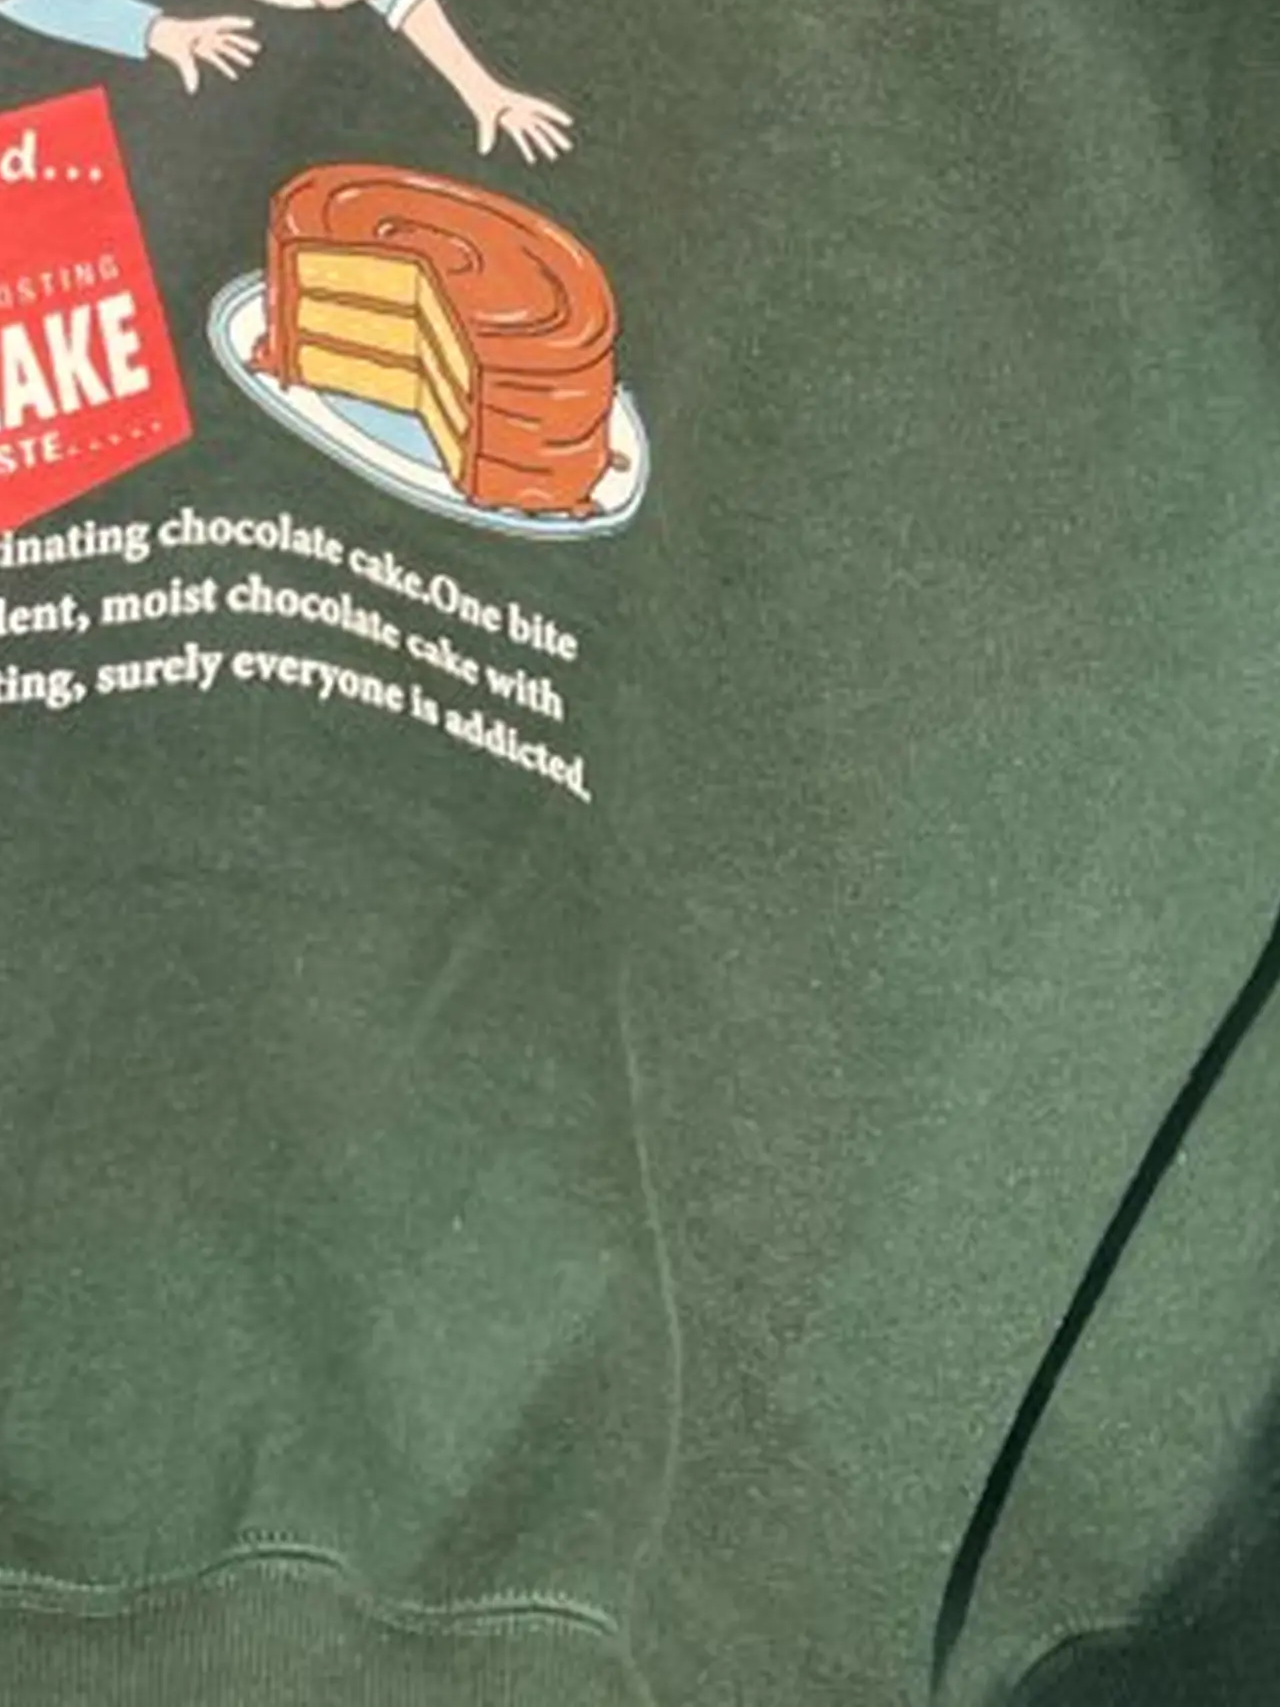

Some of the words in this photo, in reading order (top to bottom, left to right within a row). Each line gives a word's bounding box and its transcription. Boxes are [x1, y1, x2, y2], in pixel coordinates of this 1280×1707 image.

[101, 576, 219, 623] moist
[226, 572, 401, 650] chocolate
[406, 635, 480, 686] cake
[485, 664, 565, 723] with
[159, 507, 344, 565] chocolate
[508, 602, 579, 662] bite
[95, 643, 224, 692] surely
[231, 649, 406, 713] everyone
[410, 684, 441, 726] is
[444, 709, 593, 805] addicted.
